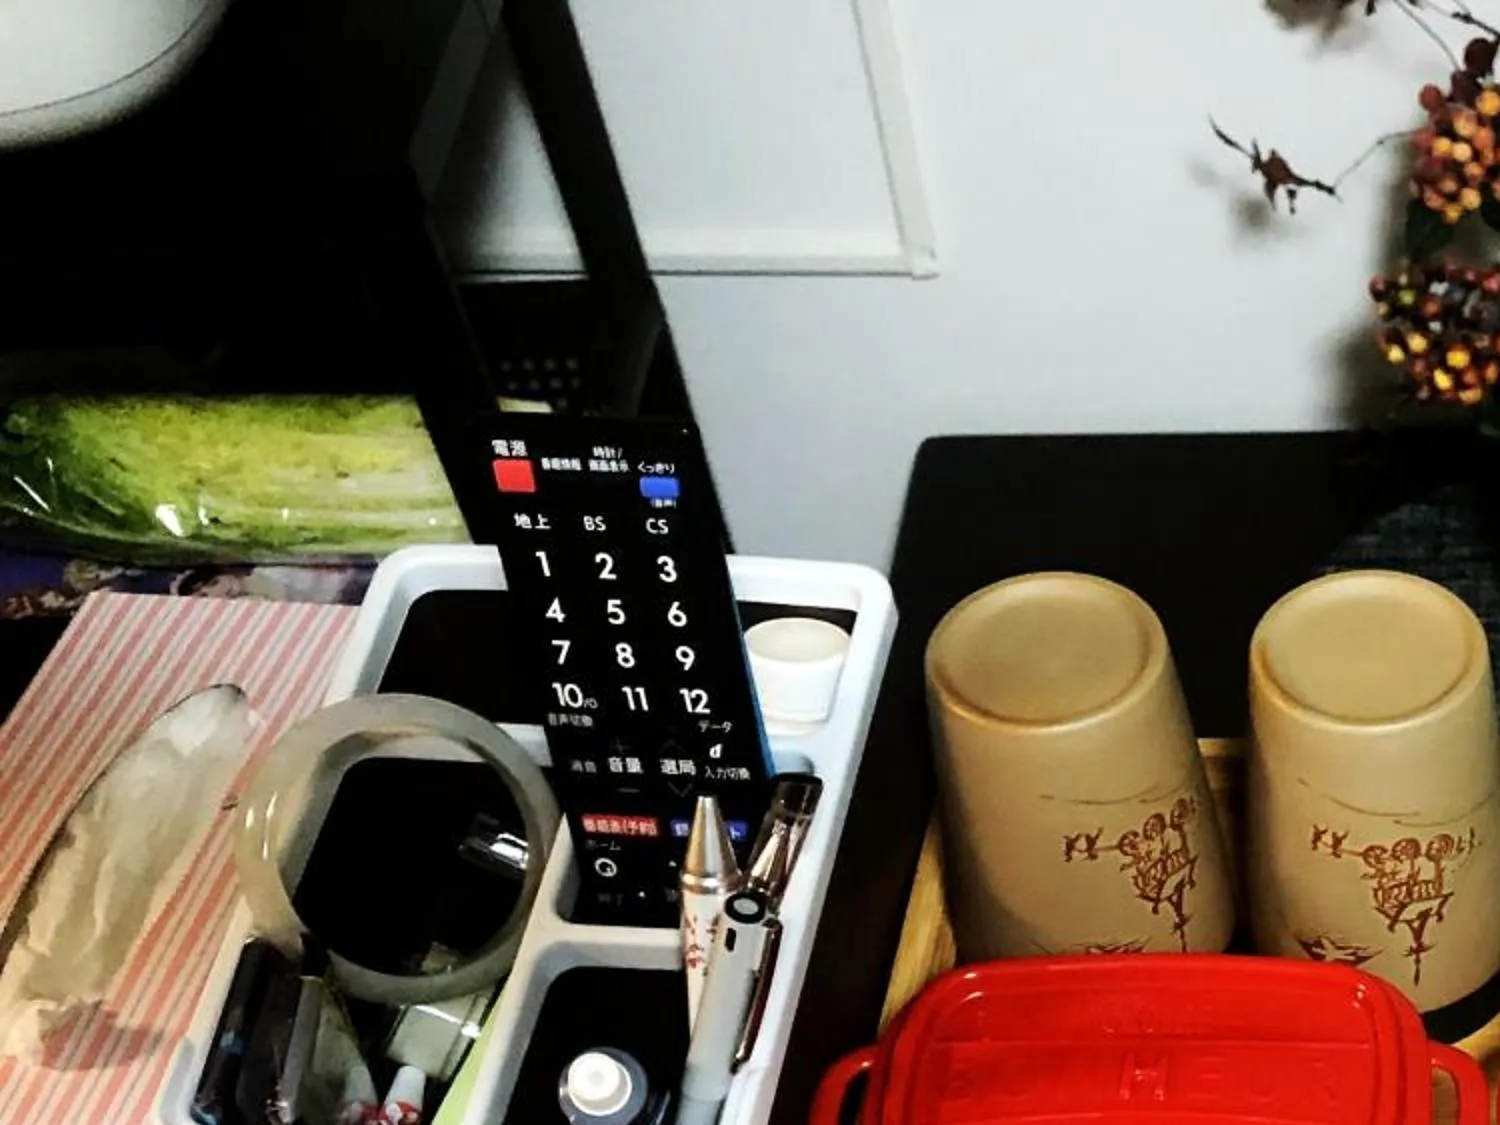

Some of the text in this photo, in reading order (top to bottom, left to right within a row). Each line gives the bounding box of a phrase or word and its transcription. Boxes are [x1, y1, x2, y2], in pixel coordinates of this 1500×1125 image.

[637, 461, 676, 475] くっきり
[513, 513, 551, 529] 地上
[583, 515, 607, 532] BS
[645, 518, 669, 534] CS
[535, 551, 551, 577] 1
[594, 553, 618, 580] 2
[656, 555, 678, 583] 3
[545, 597, 566, 623] 4
[606, 599, 627, 625] 5
[667, 601, 688, 627] 6
[551, 639, 571, 665] 7
[614, 643, 636, 668] 8
[674, 645, 695, 671] 9
[621, 686, 649, 711] 11
[679, 688, 711, 714] 12
[697, 720, 733, 733] データ
[608, 757, 644, 774] 音量
[659, 759, 696, 776] 選局
